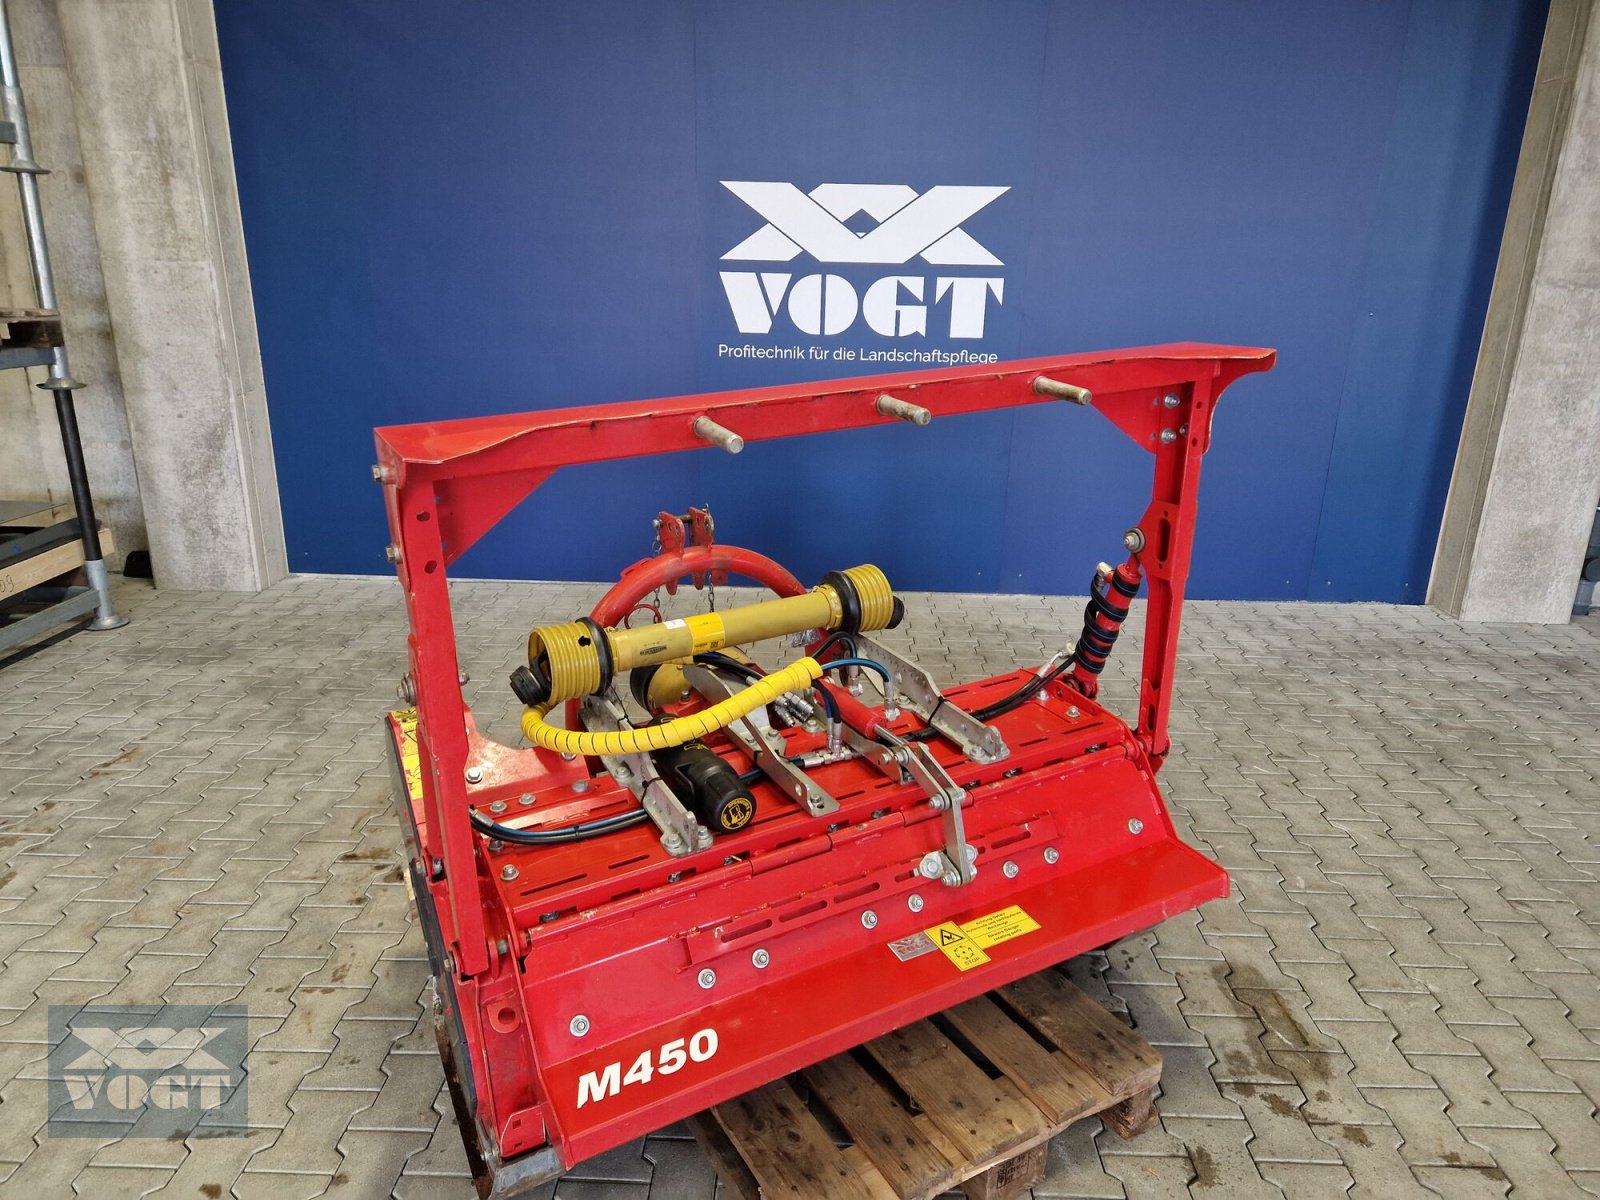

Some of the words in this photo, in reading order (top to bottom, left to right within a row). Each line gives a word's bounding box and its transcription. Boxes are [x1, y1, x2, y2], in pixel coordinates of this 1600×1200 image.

[719, 271, 1005, 339] VOGT
[718, 343, 805, 359] Profitechnik
[808, 346, 830, 360] für
[832, 346, 856, 361] die
[860, 347, 998, 366] Landschaftspflege
[964, 957, 980, 966] STOP
[576, 1028, 719, 1109] M450
